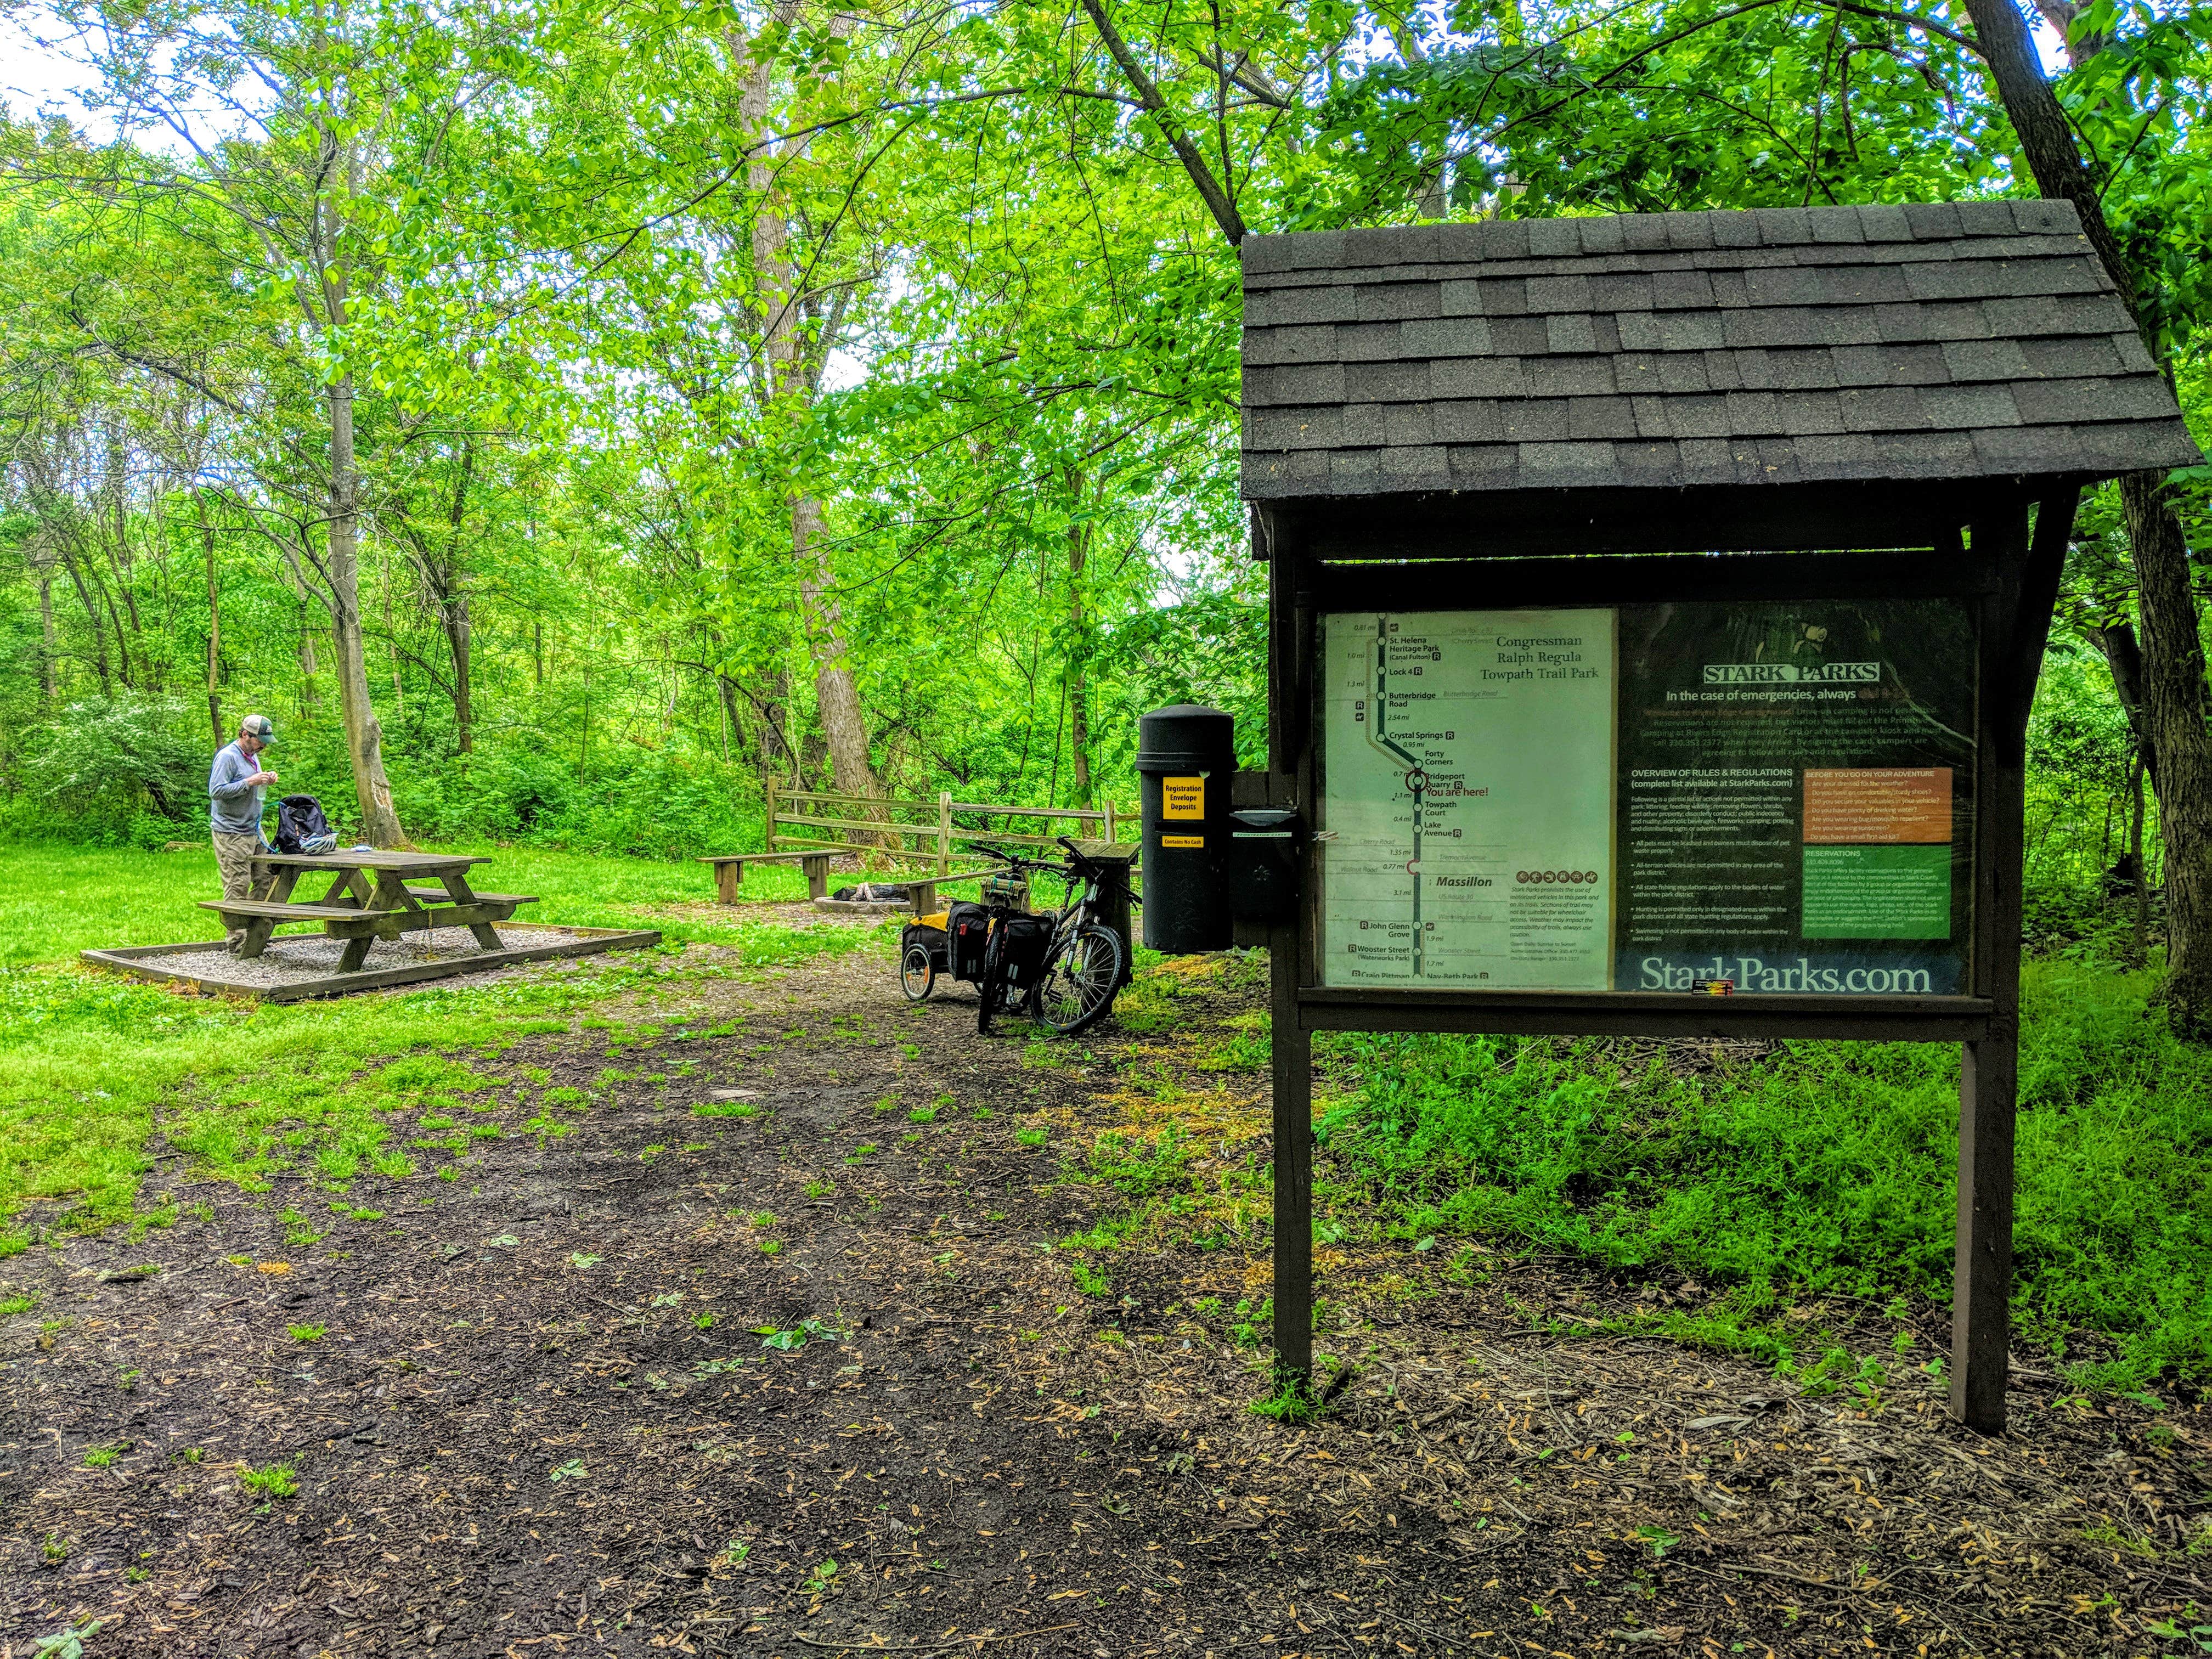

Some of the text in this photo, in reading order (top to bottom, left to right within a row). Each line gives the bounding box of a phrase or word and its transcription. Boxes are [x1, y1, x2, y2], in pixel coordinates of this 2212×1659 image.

[1497, 636, 1582, 650] Congressman
[1498, 652, 1581, 665] Ralph Regula
[1481, 668, 1598, 682] Towpath Trail Park
[1705, 664, 1878, 682] STARK PARKS
[1667, 691, 1677, 701] In
[1680, 690, 1697, 701] the
[1726, 690, 1739, 700] of
[1741, 690, 1815, 702] emergencies,
[1817, 689, 1856, 701] always
[1632, 780, 1670, 788] (complete
[1729, 779, 1792, 788] StarkParks.com)
[1426, 788, 1443, 797] You
[1464, 788, 1488, 796] here!
[1437, 877, 1492, 887] Massillon
[1640, 957, 1932, 993] StarkParks.com
